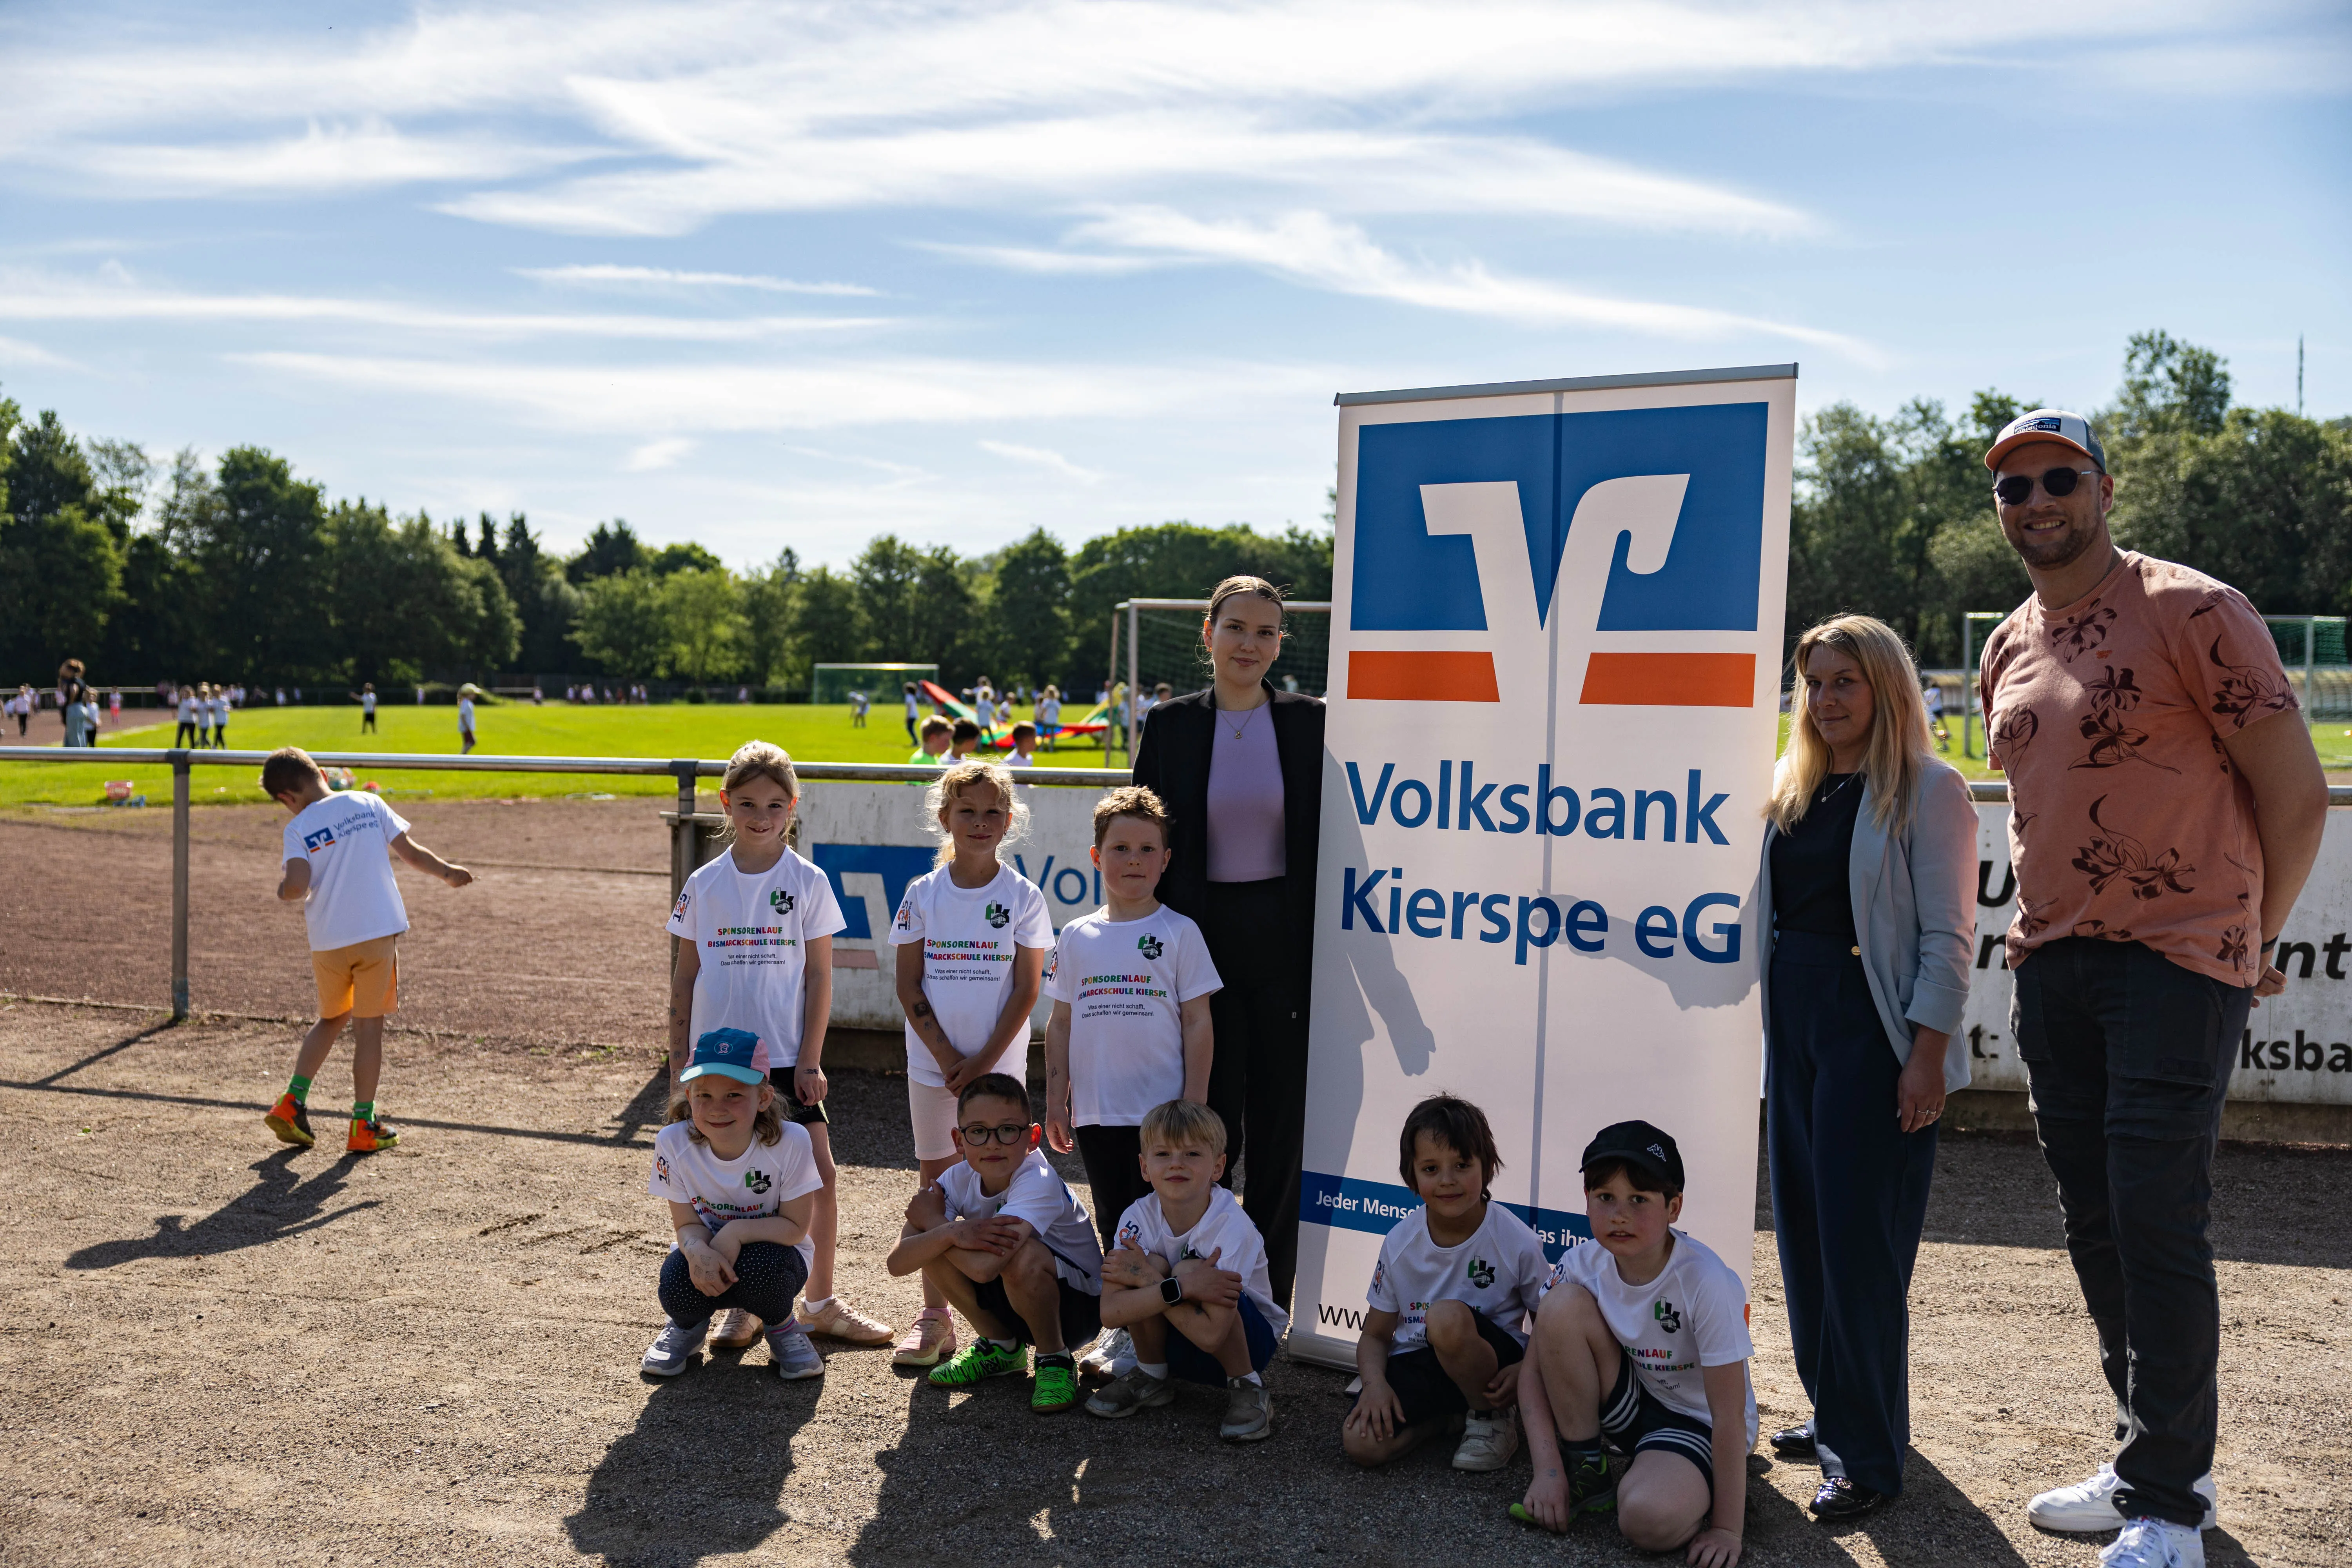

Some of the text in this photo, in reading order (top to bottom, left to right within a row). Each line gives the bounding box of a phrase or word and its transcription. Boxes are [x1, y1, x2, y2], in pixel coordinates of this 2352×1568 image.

[1345, 760, 1730, 846] Volksbank
[333, 810, 375, 830] Volksbank
[1014, 854, 1100, 905] Vol
[1341, 867, 1741, 965] Kierspe eG
[718, 927, 782, 936] SPONSORENLAUF
[708, 939, 768, 947] BISMARCKSCHULE
[927, 939, 998, 949] SPONSORENLAUF
[924, 952, 981, 960] SMARCKSCHULE
[2275, 933, 2352, 980] nt
[1082, 975, 1151, 986] SPONSORENLAUF
[1136, 988, 1167, 998] KIERSPE
[1968, 1024, 1998, 1058] t:
[2241, 1028, 2352, 1073] ksba
[691, 1196, 764, 1212] SPONSORENLAUF
[1316, 1191, 1359, 1211] Jeder
[1318, 1303, 1369, 1331] ww
[1624, 1346, 1673, 1359] RENLAUF
[1655, 1362, 1695, 1371] KIERSPE
